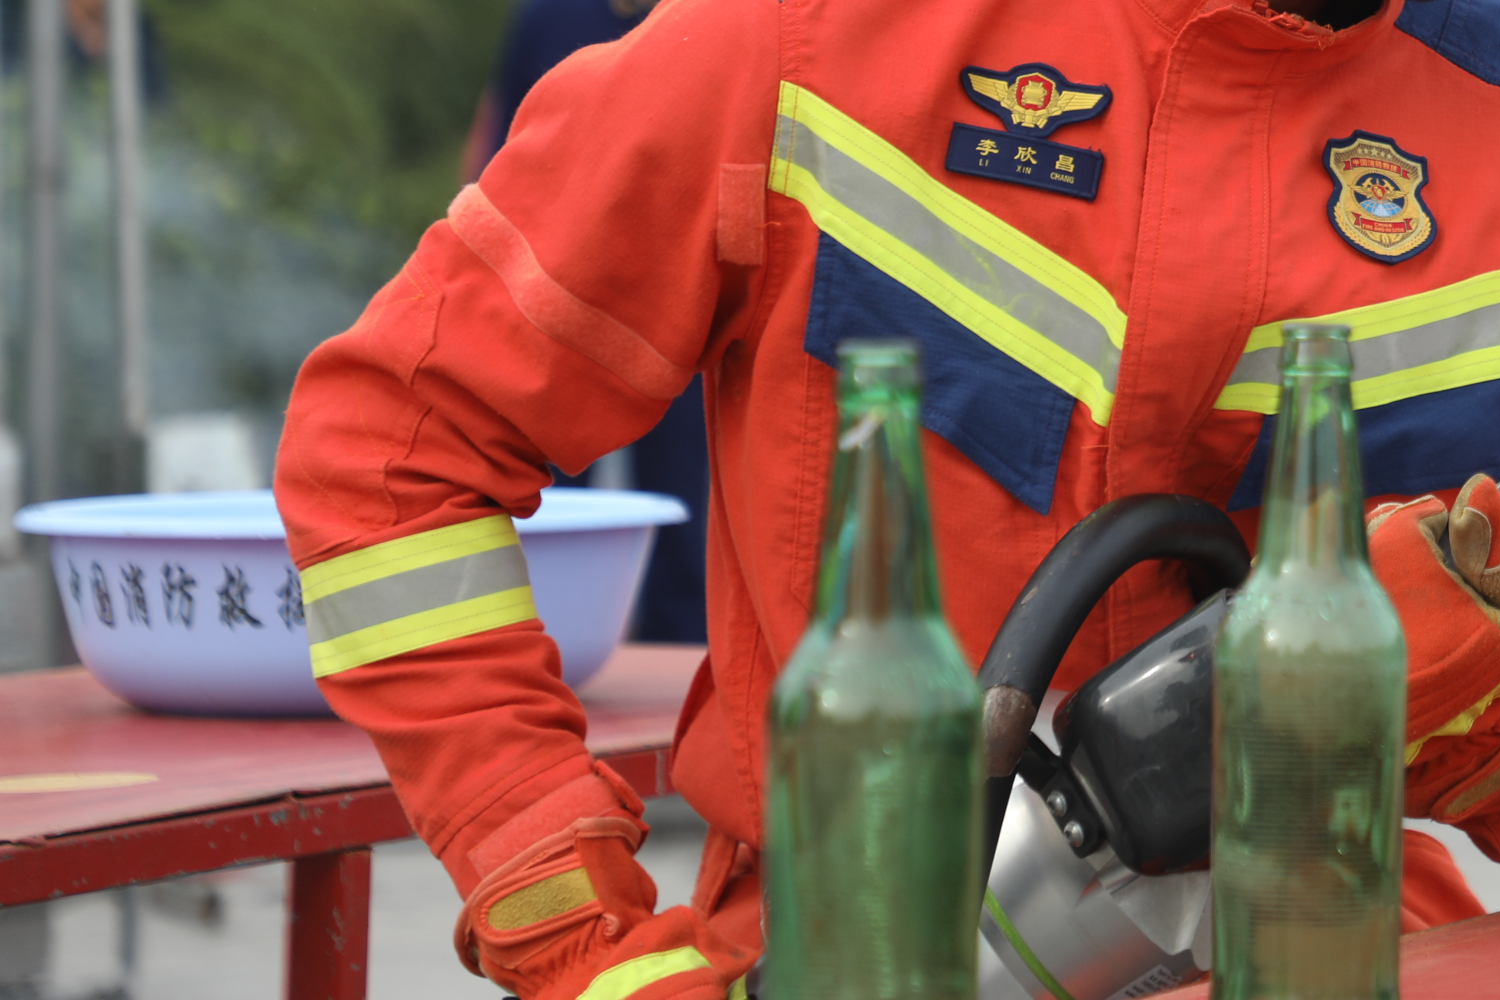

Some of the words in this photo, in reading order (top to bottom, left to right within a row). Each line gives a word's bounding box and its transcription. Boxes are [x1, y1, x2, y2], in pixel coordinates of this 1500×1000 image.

[979, 158, 990, 168] LI
[1016, 164, 1032, 175] XIN
[1050, 171, 1075, 184] CHANG
